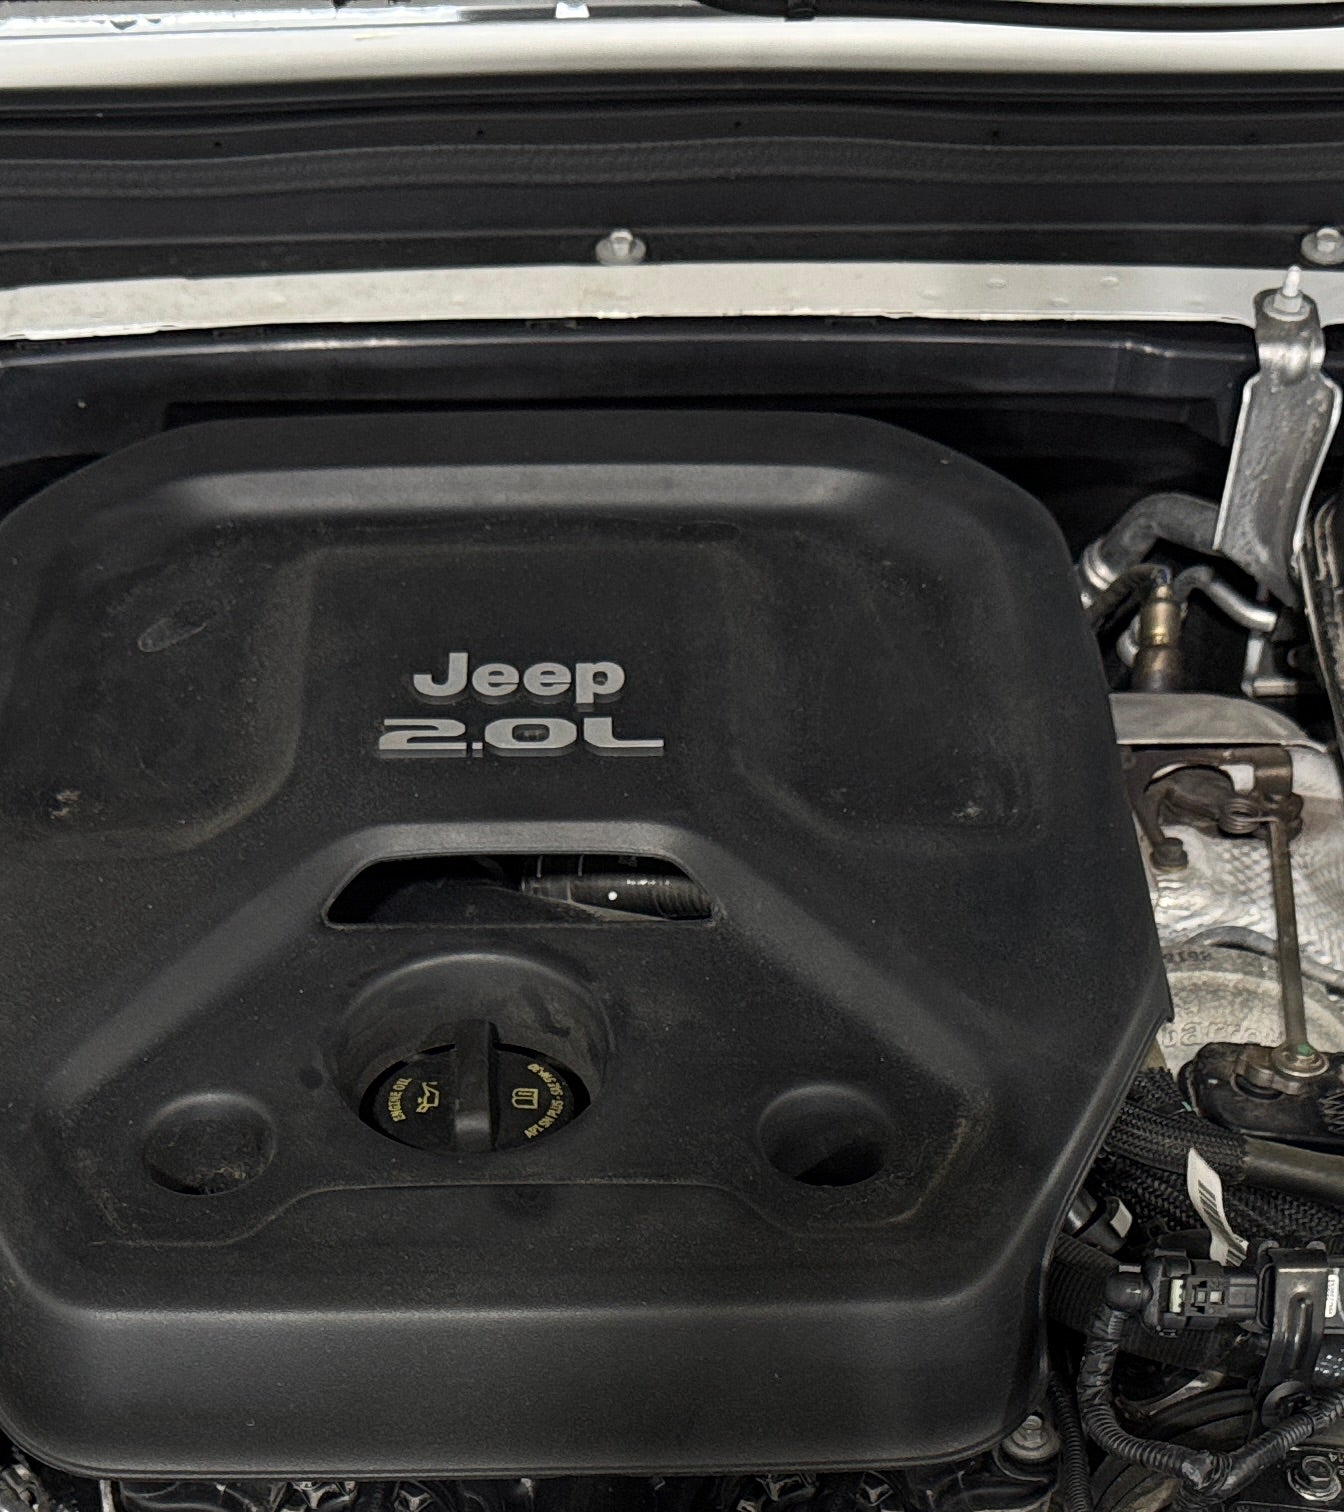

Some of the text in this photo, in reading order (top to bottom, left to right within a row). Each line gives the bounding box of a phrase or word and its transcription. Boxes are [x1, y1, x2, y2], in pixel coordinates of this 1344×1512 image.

[413, 652, 625, 704] Jeep
[378, 717, 665, 752] 2.0L
[395, 1077, 413, 1092] OIL
